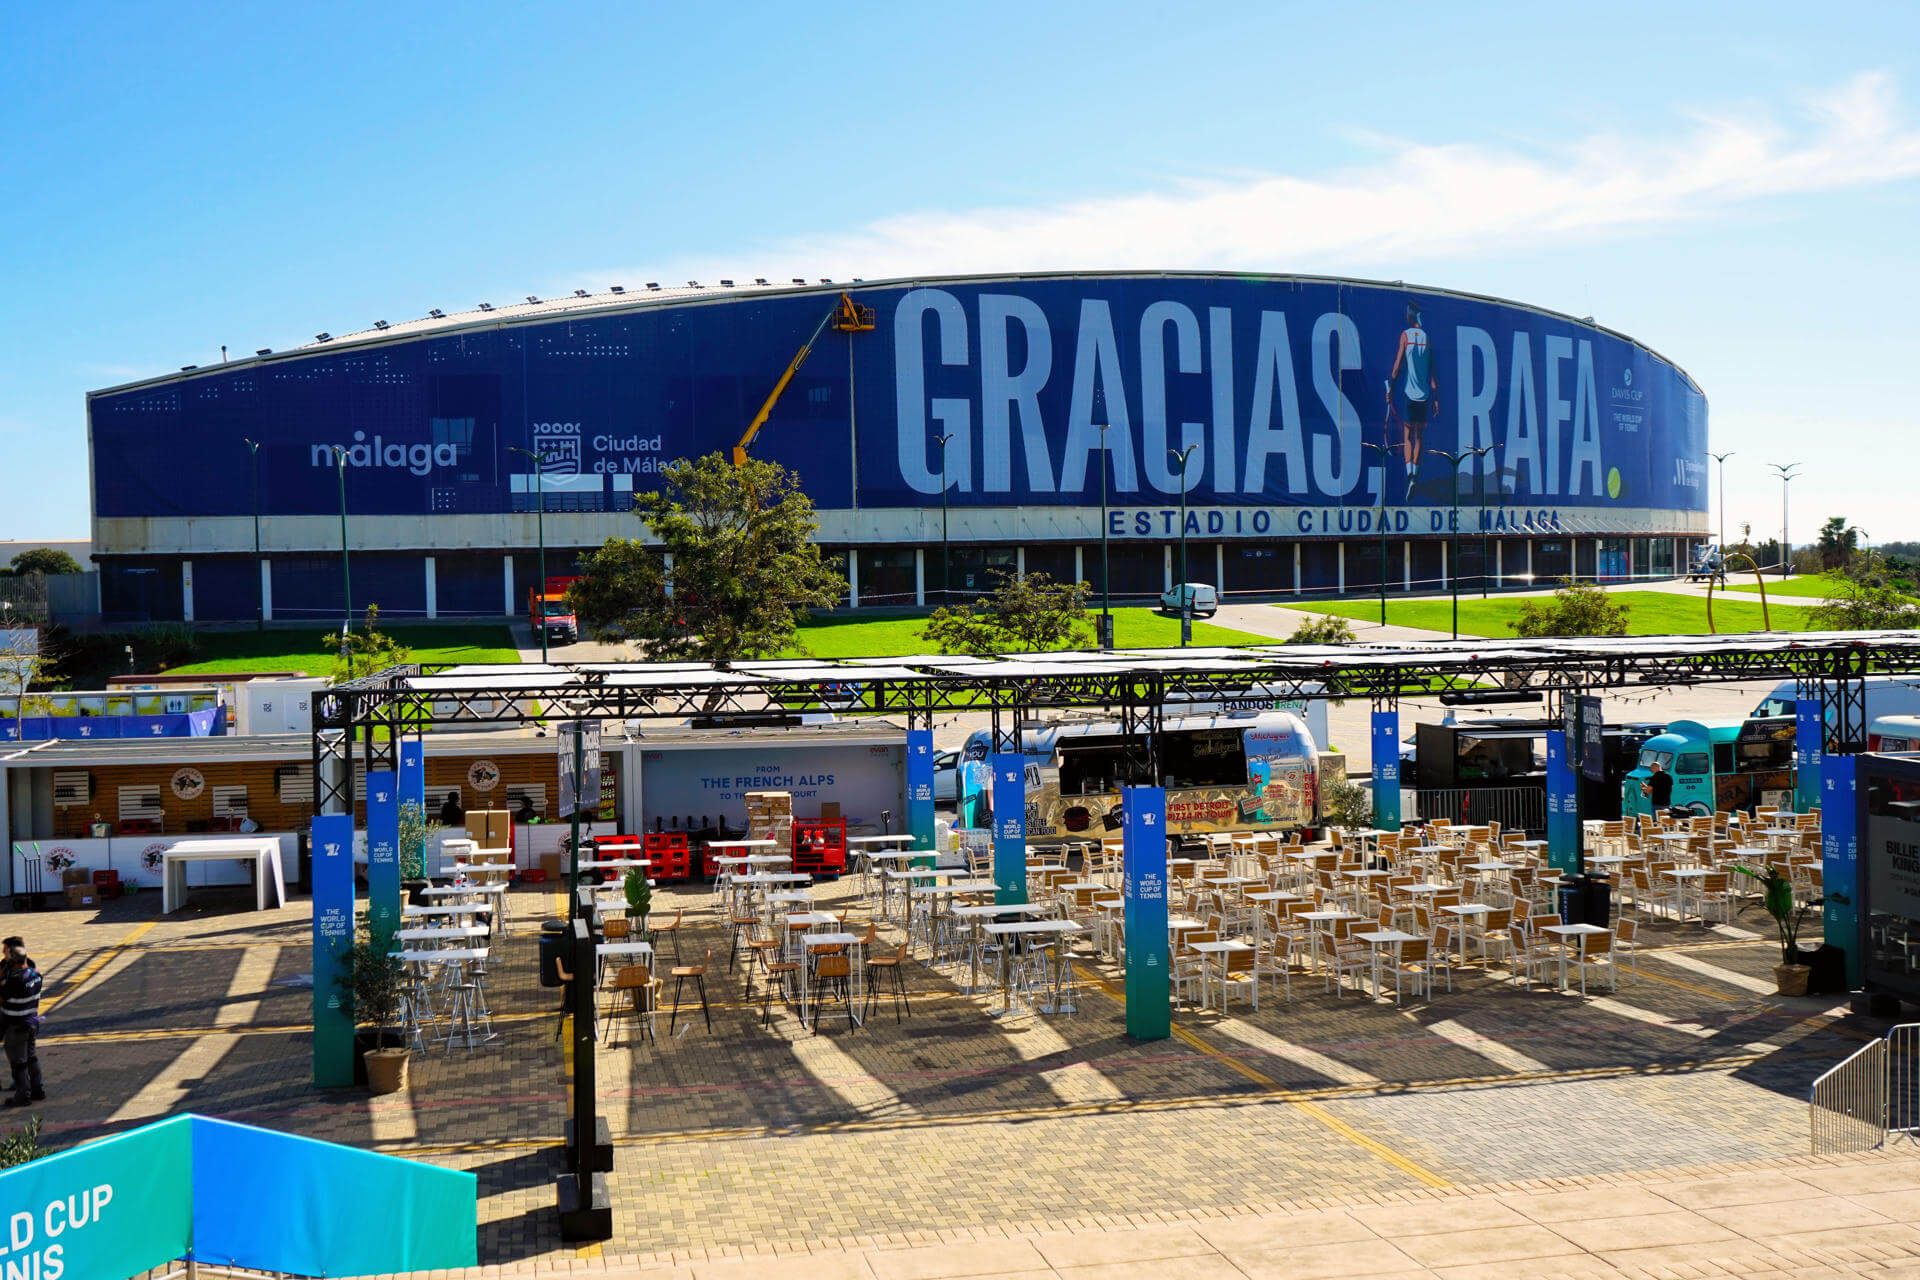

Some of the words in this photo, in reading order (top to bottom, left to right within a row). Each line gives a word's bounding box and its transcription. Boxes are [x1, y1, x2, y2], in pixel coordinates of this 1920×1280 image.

[593, 435, 662, 451] Ciudad
[593, 457, 618, 474] de
[1109, 510, 1271, 535] ESTADIO
[1297, 509, 1410, 534] CIUDAD
[1430, 509, 1459, 532] DE
[702, 778, 730, 789] THE
[735, 776, 793, 788] FRENCH
[799, 774, 835, 786] ALPS
[788, 790, 817, 798] OURT
[1168, 804, 1191, 812] FIRST
[1194, 801, 1230, 811] DETROIT
[1168, 812, 1192, 821] PIZZA
[1205, 810, 1232, 819] TOWN
[1886, 840, 1919, 859] BILLIE
[45, 1183, 113, 1238] CUP
